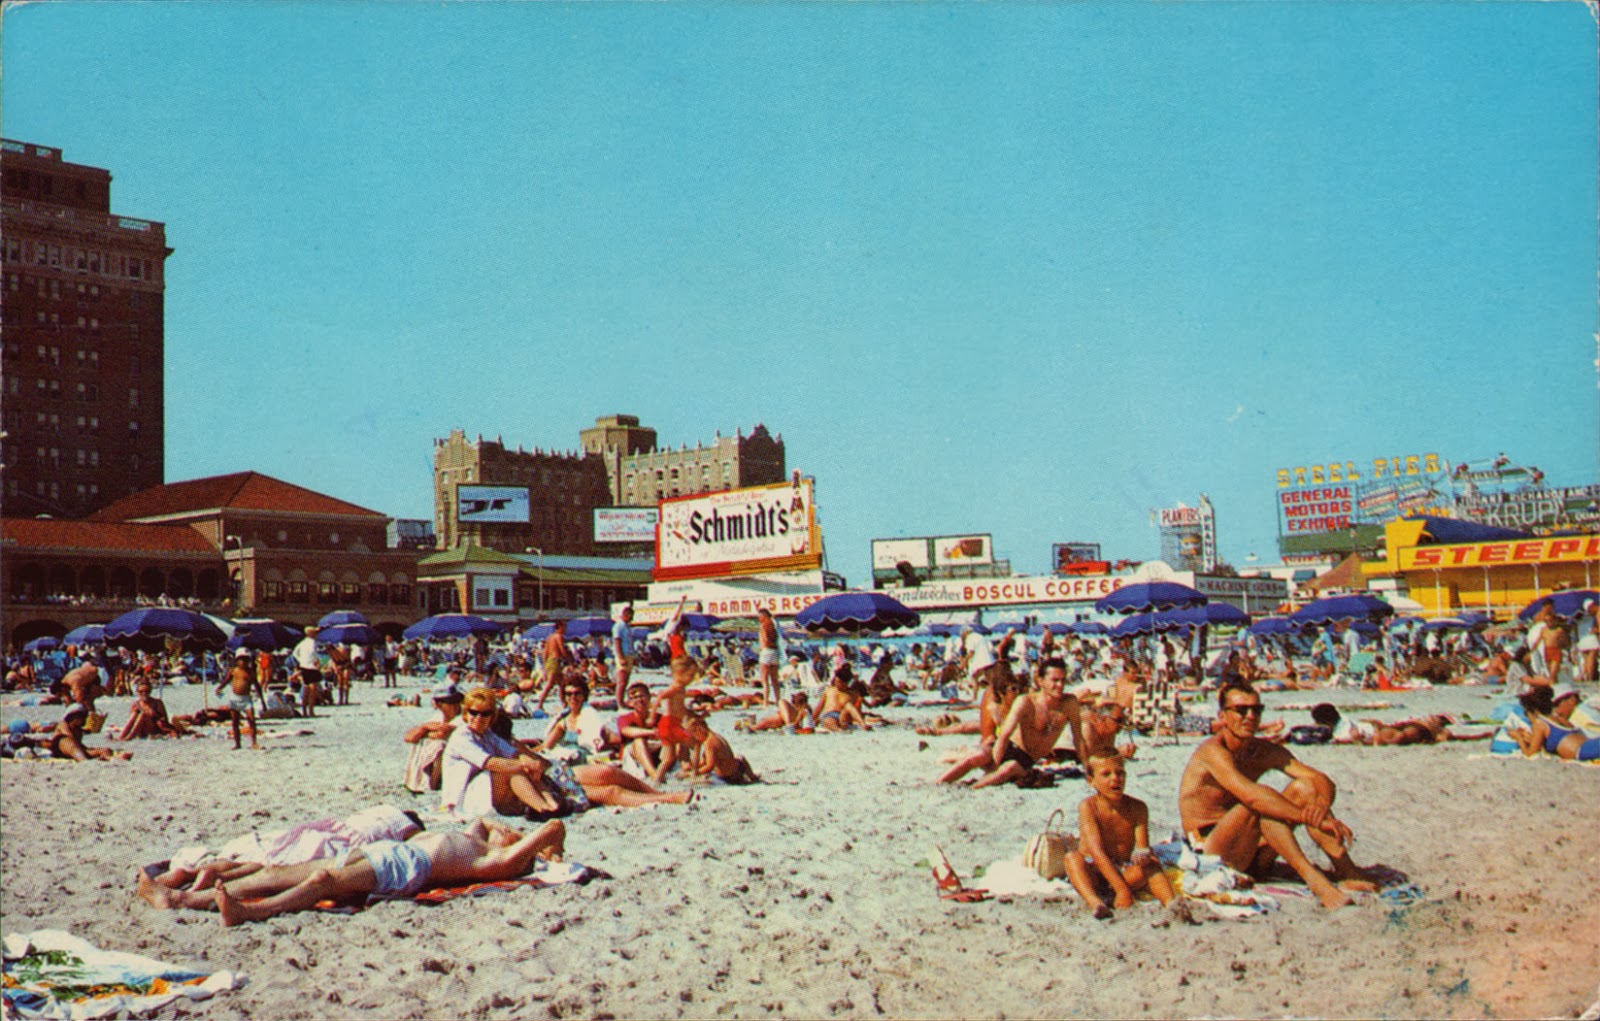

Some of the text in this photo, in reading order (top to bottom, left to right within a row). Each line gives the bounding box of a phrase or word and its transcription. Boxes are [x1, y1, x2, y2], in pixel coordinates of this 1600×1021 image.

[1277, 461, 1360, 487] STEEL
[1373, 453, 1439, 478] PIER
[1281, 487, 1352, 504] GENERAL
[1161, 507, 1200, 524] PLANTERS
[1285, 500, 1352, 518] MOTORS
[689, 500, 789, 545] Schmidt's
[1288, 515, 1351, 532] EXHIBIT
[1203, 514, 1214, 574] PEANUTS
[963, 582, 1036, 600] BOSCUL
[1045, 578, 1123, 597] COFFEE
[708, 597, 777, 614] MAMMY'S
